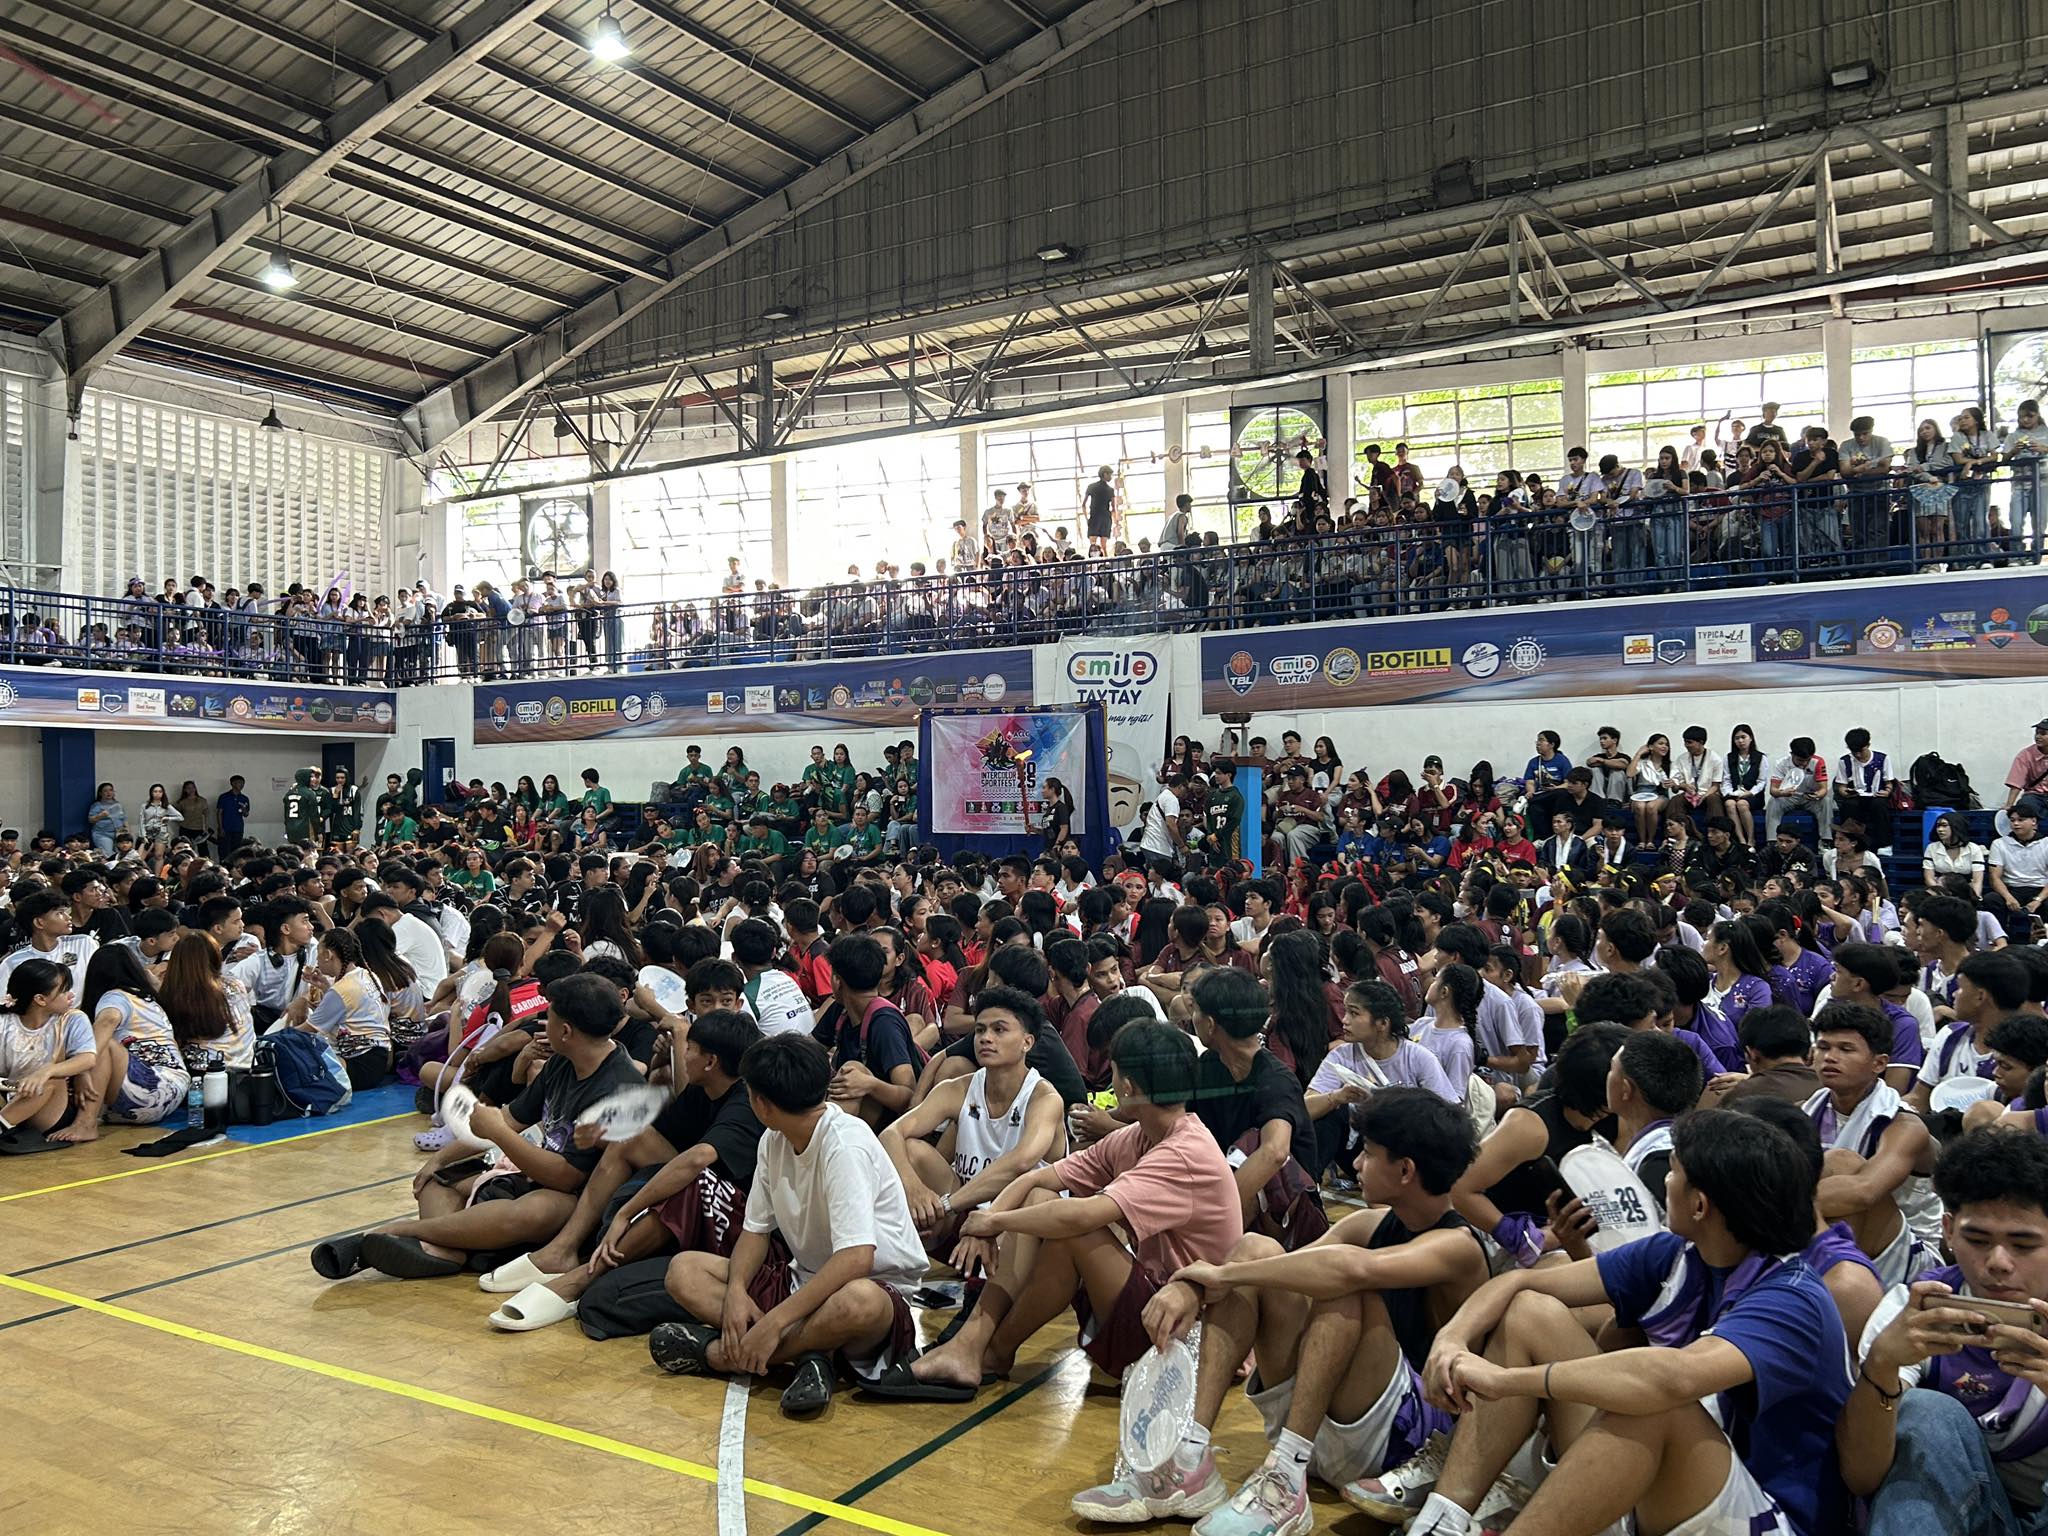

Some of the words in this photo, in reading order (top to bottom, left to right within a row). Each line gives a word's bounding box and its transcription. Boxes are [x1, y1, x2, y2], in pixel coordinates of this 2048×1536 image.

[1697, 630, 1725, 640] TYPICA
[1075, 652, 1147, 676] smile
[1275, 656, 1313, 670] smile
[1370, 650, 1448, 670] BOFILL
[1230, 676, 1253, 686] TBL
[1277, 674, 1311, 684] TAYTAY
[1077, 689, 1142, 705] TAYTAY
[571, 700, 614, 714] BOFILL
[1107, 714, 1126, 726] may
[981, 771, 1017, 780] INTERCOLOR
[981, 779, 1016, 787] SPORTFEST
[288, 801, 299, 818] 2
[1614, 1186, 1642, 1209] 20
[1622, 1206, 1648, 1223] 25
